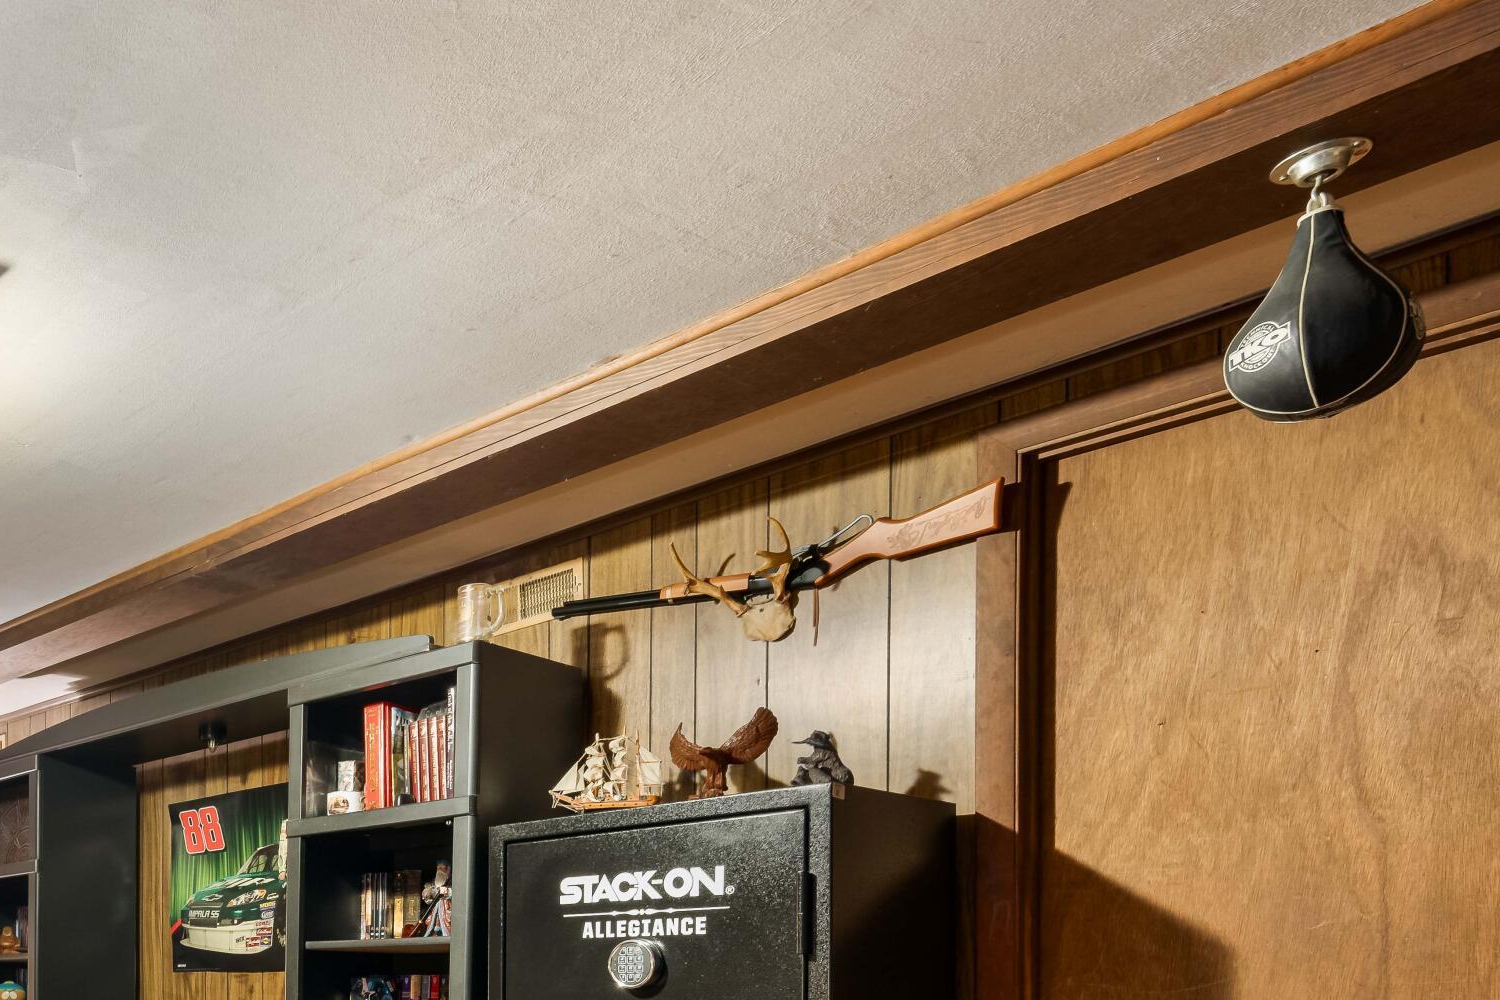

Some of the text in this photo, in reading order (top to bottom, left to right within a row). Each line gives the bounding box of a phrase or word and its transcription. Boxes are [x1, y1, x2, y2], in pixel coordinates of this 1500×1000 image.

[1229, 327, 1289, 369] TKO
[179, 805, 225, 855] 88
[582, 916, 707, 939] ALLEGIANCE
